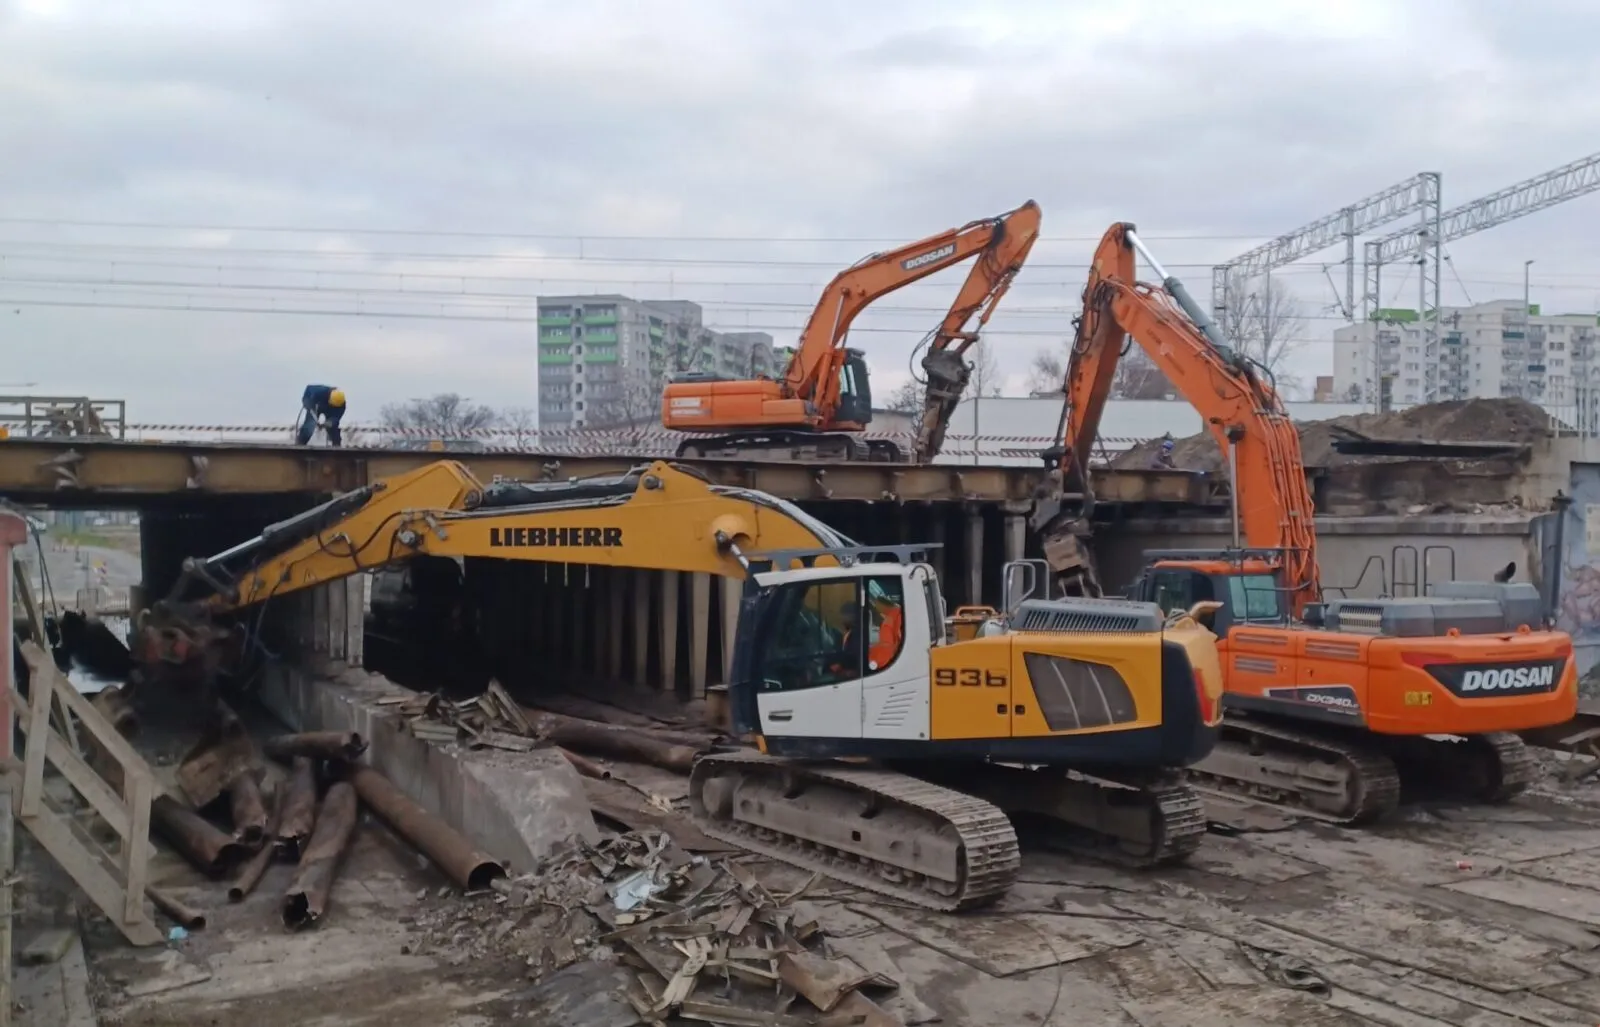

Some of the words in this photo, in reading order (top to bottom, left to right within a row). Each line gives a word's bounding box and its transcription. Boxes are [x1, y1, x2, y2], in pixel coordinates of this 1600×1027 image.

[905, 243, 954, 269] DOOSAN
[490, 527, 622, 546] LIEBHERR
[1461, 665, 1554, 691] DOOSAN
